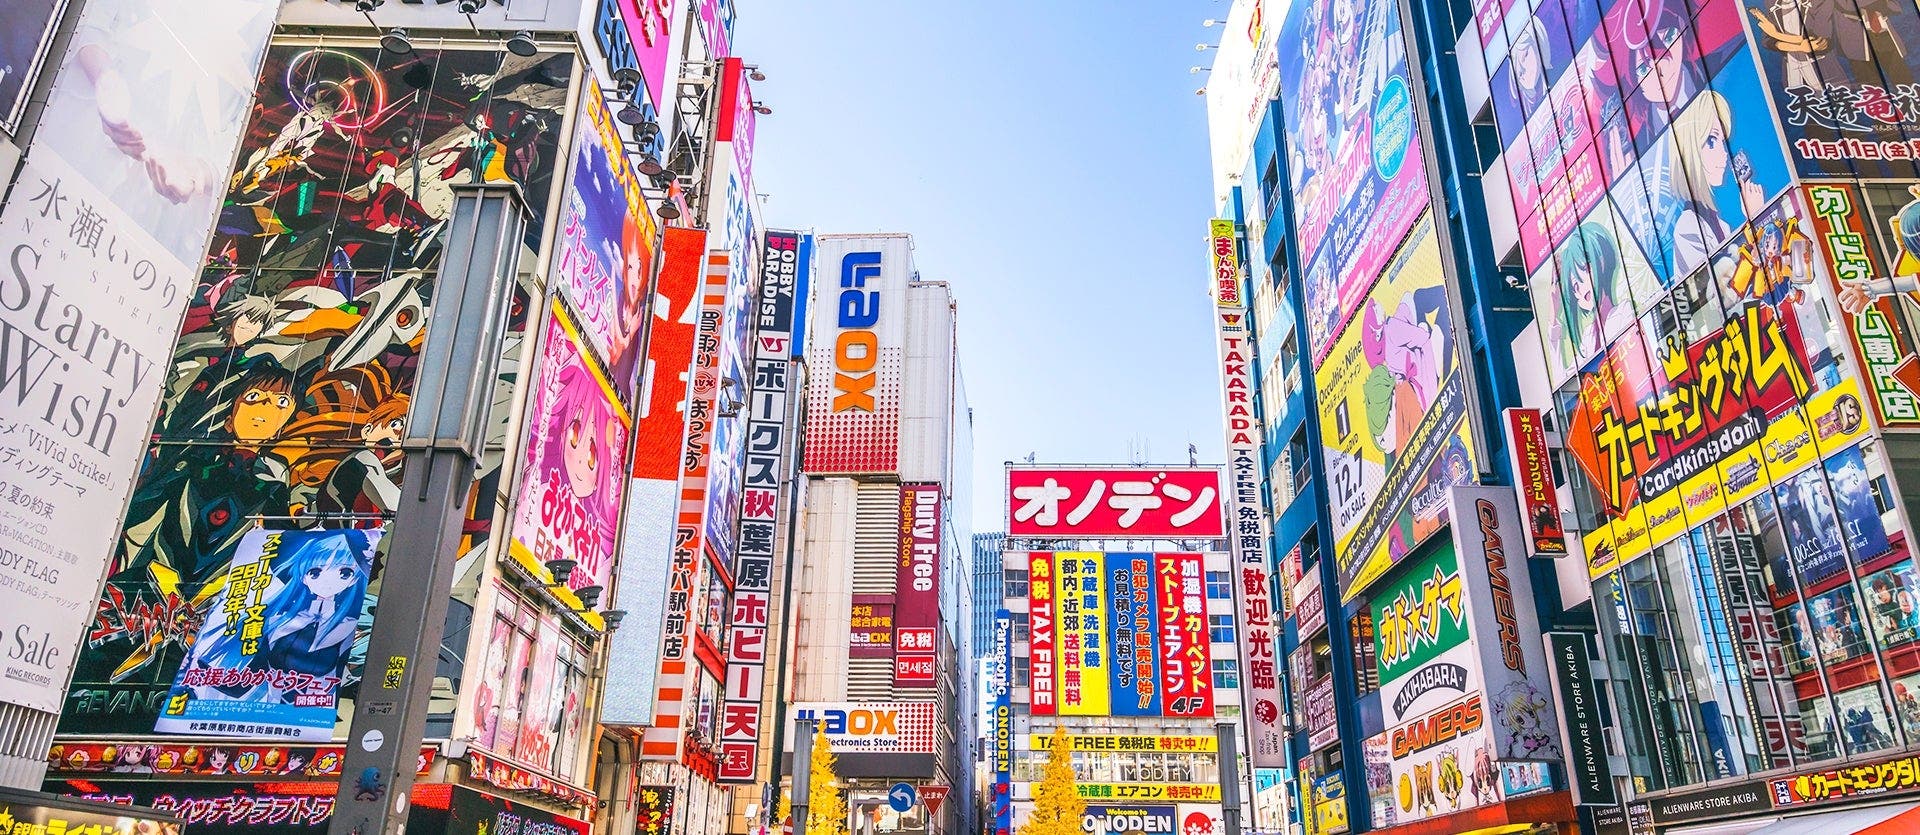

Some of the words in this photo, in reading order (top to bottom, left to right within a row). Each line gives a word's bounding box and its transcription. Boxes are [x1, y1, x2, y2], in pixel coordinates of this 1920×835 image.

[29, 177, 177, 309] 水瀬いのり
[780, 236, 796, 298] HOBBY
[760, 236, 781, 328] PARADISE
[1215, 237, 1240, 303] まんが喫茶
[0, 244, 155, 408] Starry
[0, 317, 120, 458] Wish
[1222, 337, 1252, 445] TAKARADA
[1598, 303, 1810, 511] カードキングダム
[901, 490, 915, 535] Flagship
[912, 490, 939, 539] Duty
[1013, 471, 1216, 528] オノデン
[1351, 491, 1367, 519] SALE
[902, 536, 914, 568] Store
[1238, 506, 1263, 564] 免税商店
[24, 559, 60, 585] FLAG
[912, 543, 938, 592] Free
[1031, 557, 1050, 600] 免税
[1475, 498, 1527, 680] GAMERS
[8, 623, 60, 671] Sale
[900, 631, 933, 648] 免税
[1033, 605, 1051, 645] TAX
[1113, 568, 1133, 688] お見積り無料です
[1242, 567, 1277, 690] 歓迎光臨
[181, 667, 342, 693] 応援ありがとうフェア
[899, 661, 933, 674] 면세점
[996, 618, 1010, 698] Panasonic
[1034, 649, 1052, 706] FREE
[1564, 644, 1580, 680] AKIBA
[1171, 697, 1203, 714] 4F
[1572, 682, 1588, 719] STORE
[997, 705, 1009, 772] ONODEN
[1073, 737, 1116, 749] FREE
[1118, 737, 1155, 750] 免税店
[1391, 697, 1483, 760] GAMERS
[1578, 722, 1600, 793] ALIENWARE
[923, 790, 944, 800] 止まれ
[1077, 784, 1112, 798] 冷蔵庫
[1117, 786, 1163, 798] エアコン
[1106, 808, 1134, 816] Welcome
[1135, 808, 1148, 816] to
[1662, 799, 1704, 815] ALIENWARE
[1704, 796, 1731, 811] STORE
[1732, 792, 1759, 806] AKIBA
[1082, 815, 1172, 833] ONODEN
